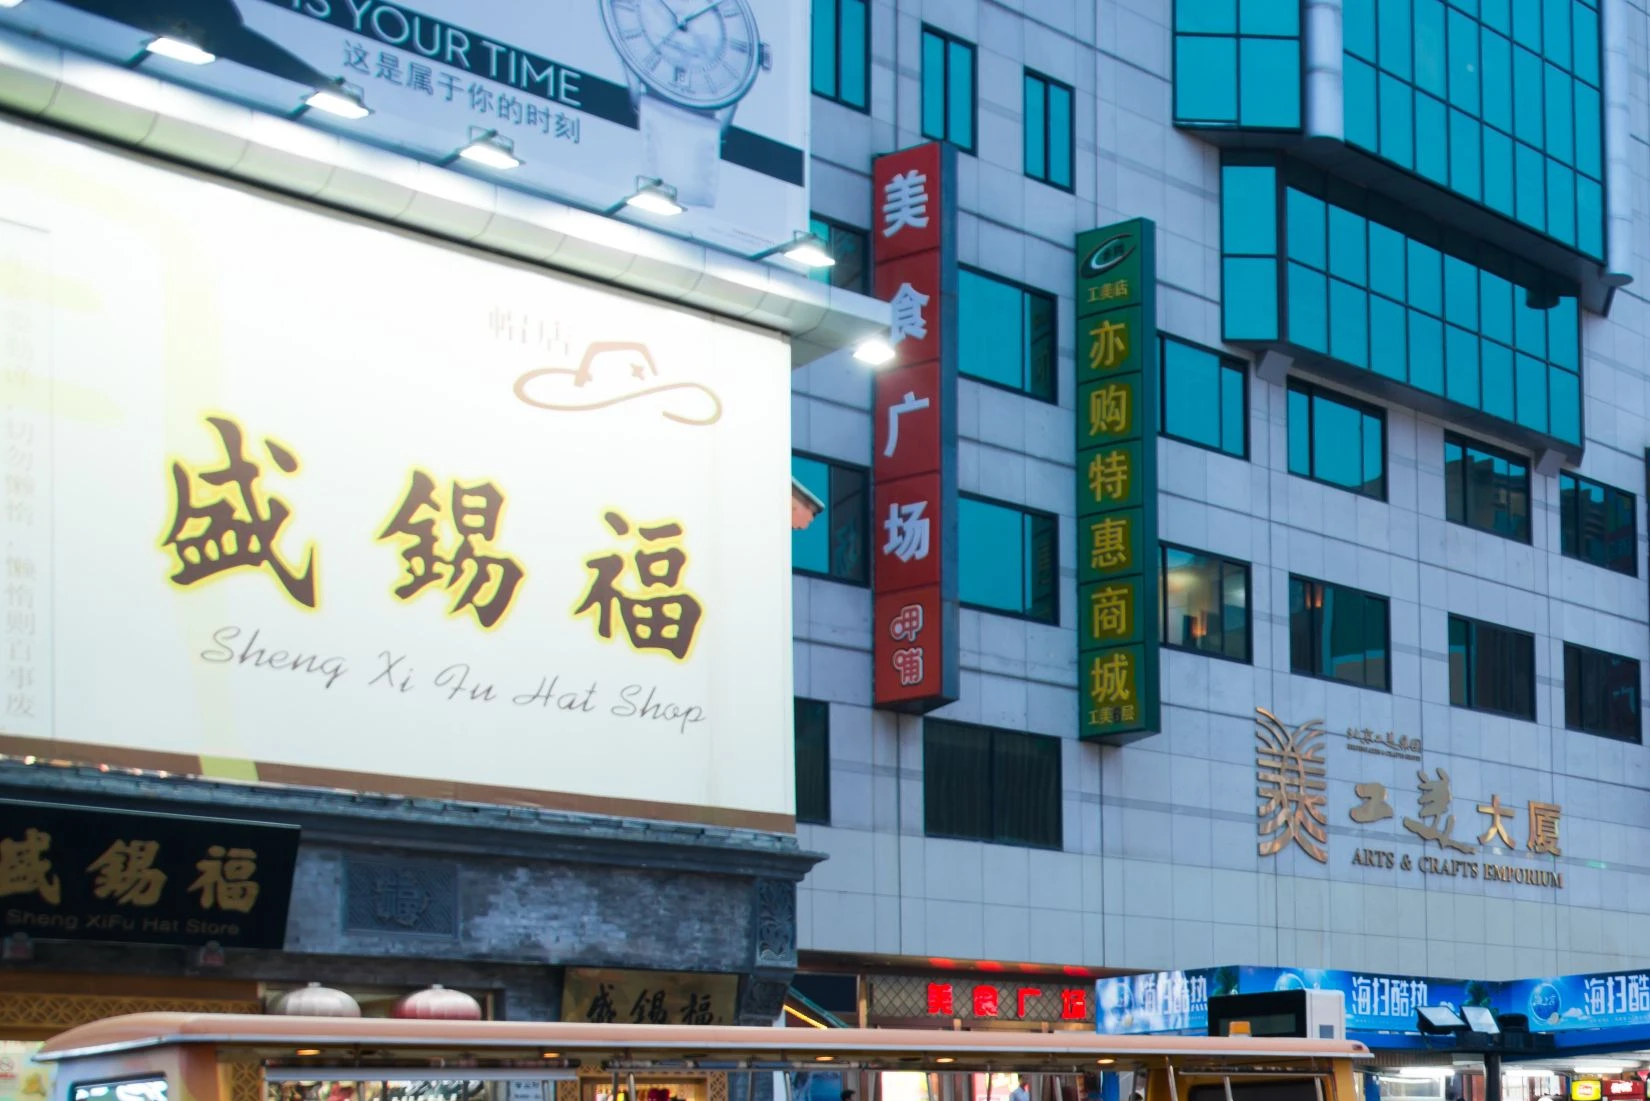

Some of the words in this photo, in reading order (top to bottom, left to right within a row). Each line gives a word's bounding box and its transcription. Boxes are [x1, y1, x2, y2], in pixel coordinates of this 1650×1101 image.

[343, 40, 581, 145] 这是属于你的时刻
[345, 0, 471, 69] YOUR
[480, 40, 582, 106] TIME
[882, 170, 930, 561] 美食广场
[162, 415, 705, 661] 盛錫福
[1088, 320, 1131, 702] 亦购特惠商城
[200, 625, 348, 689] Sheng
[368, 650, 414, 694] Xi
[435, 662, 496, 705] Fu
[512, 674, 597, 714] Hat
[610, 684, 707, 733] Shop
[890, 604, 923, 686] 呷哺
[1352, 848, 1395, 870] ARTS
[1400, 853, 1412, 871] &
[1418, 855, 1479, 878] CRAFTS
[1483, 863, 1564, 889] EMPORIUM
[7, 909, 79, 930] Sheng
[86, 913, 135, 931] XiFu
[142, 916, 179, 933] Hat
[186, 918, 240, 936] Store
